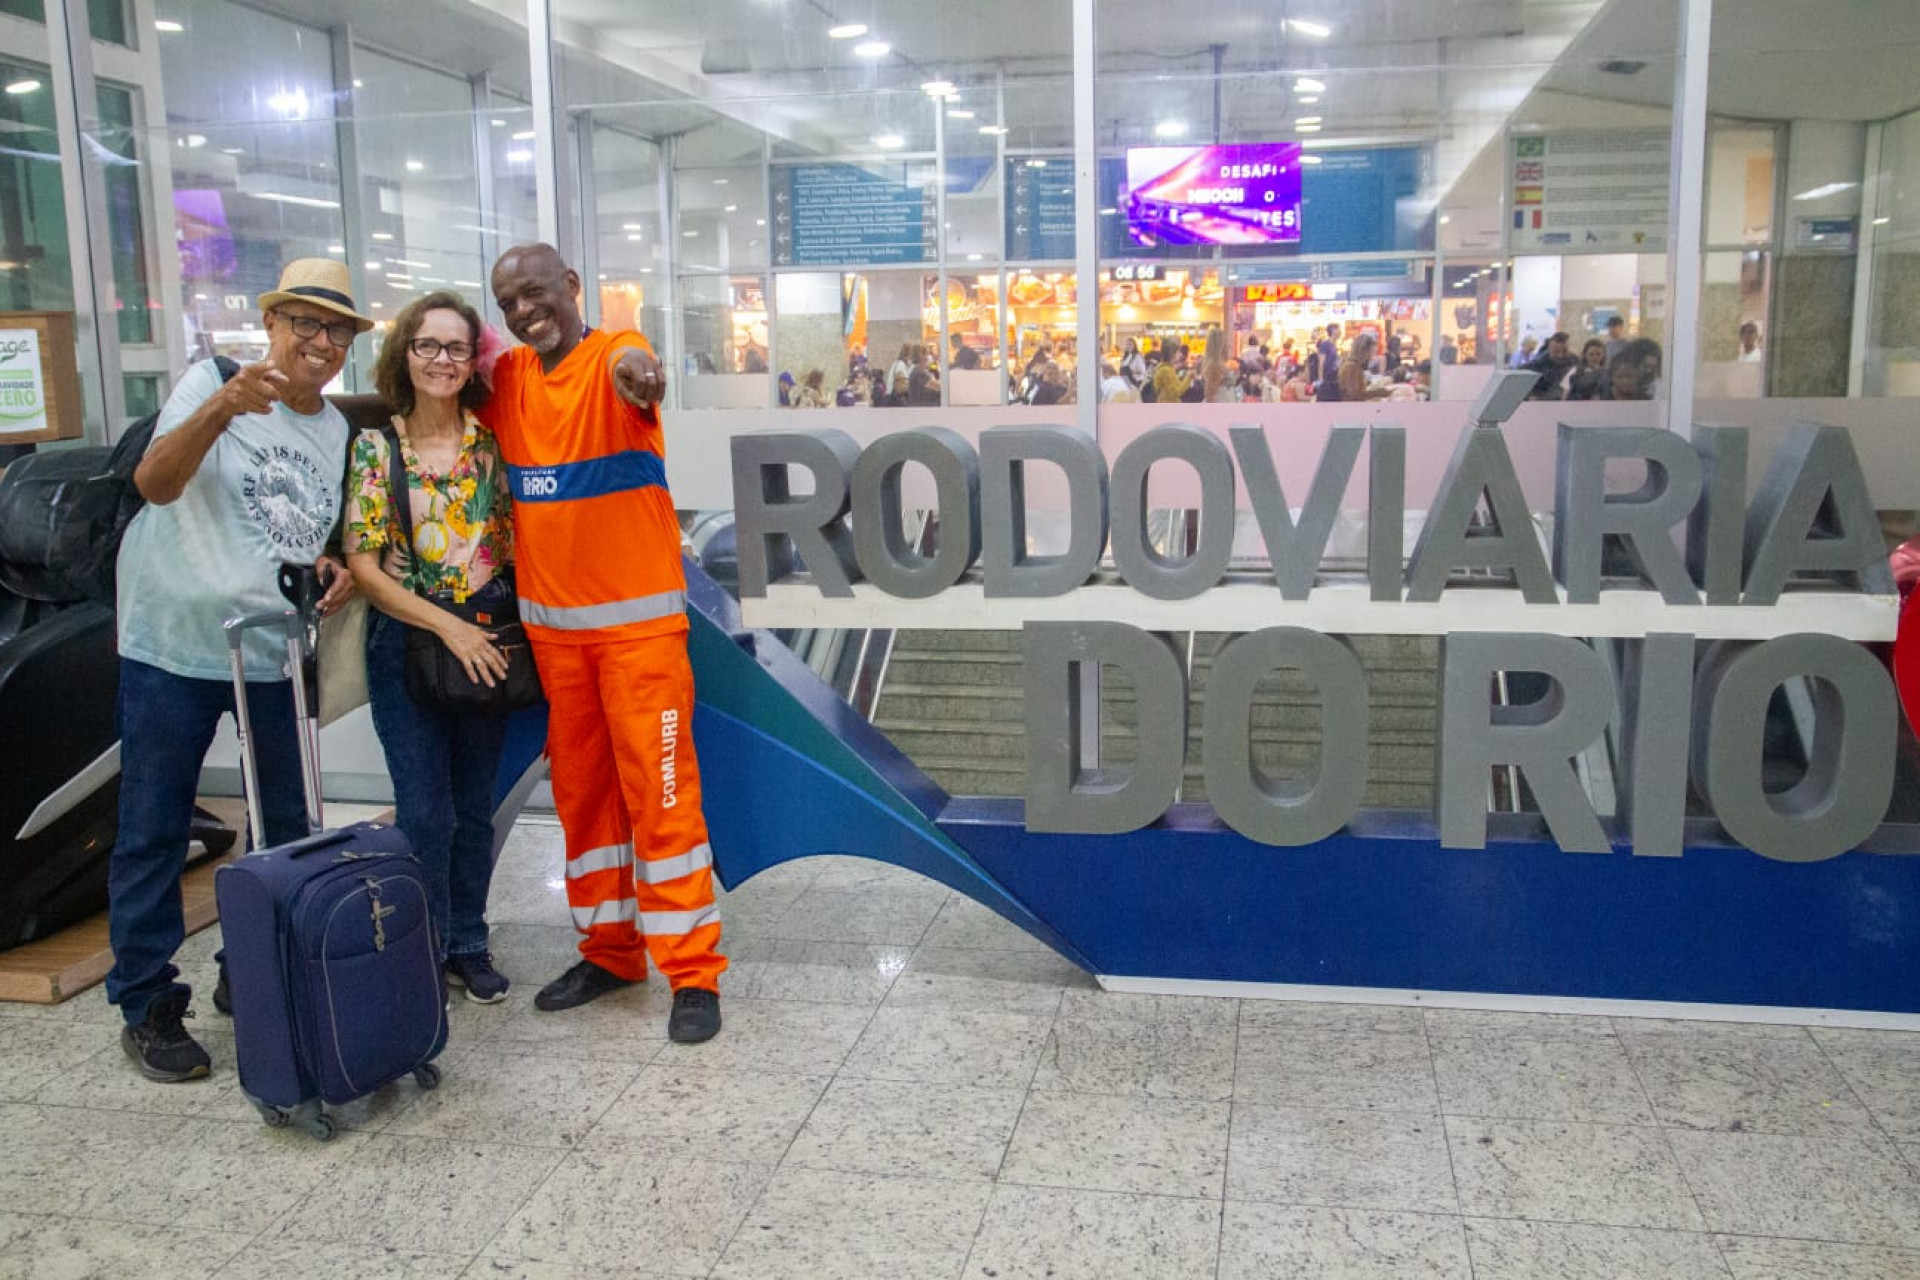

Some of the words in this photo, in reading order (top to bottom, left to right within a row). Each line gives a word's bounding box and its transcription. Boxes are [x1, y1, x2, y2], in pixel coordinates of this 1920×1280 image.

[531, 476, 558, 496] RIO
[730, 369, 1893, 606] RODOVIÁRIA
[661, 708, 678, 809] COMLURB
[1023, 619, 1369, 847] DO
[1437, 631, 1899, 863] RIO
